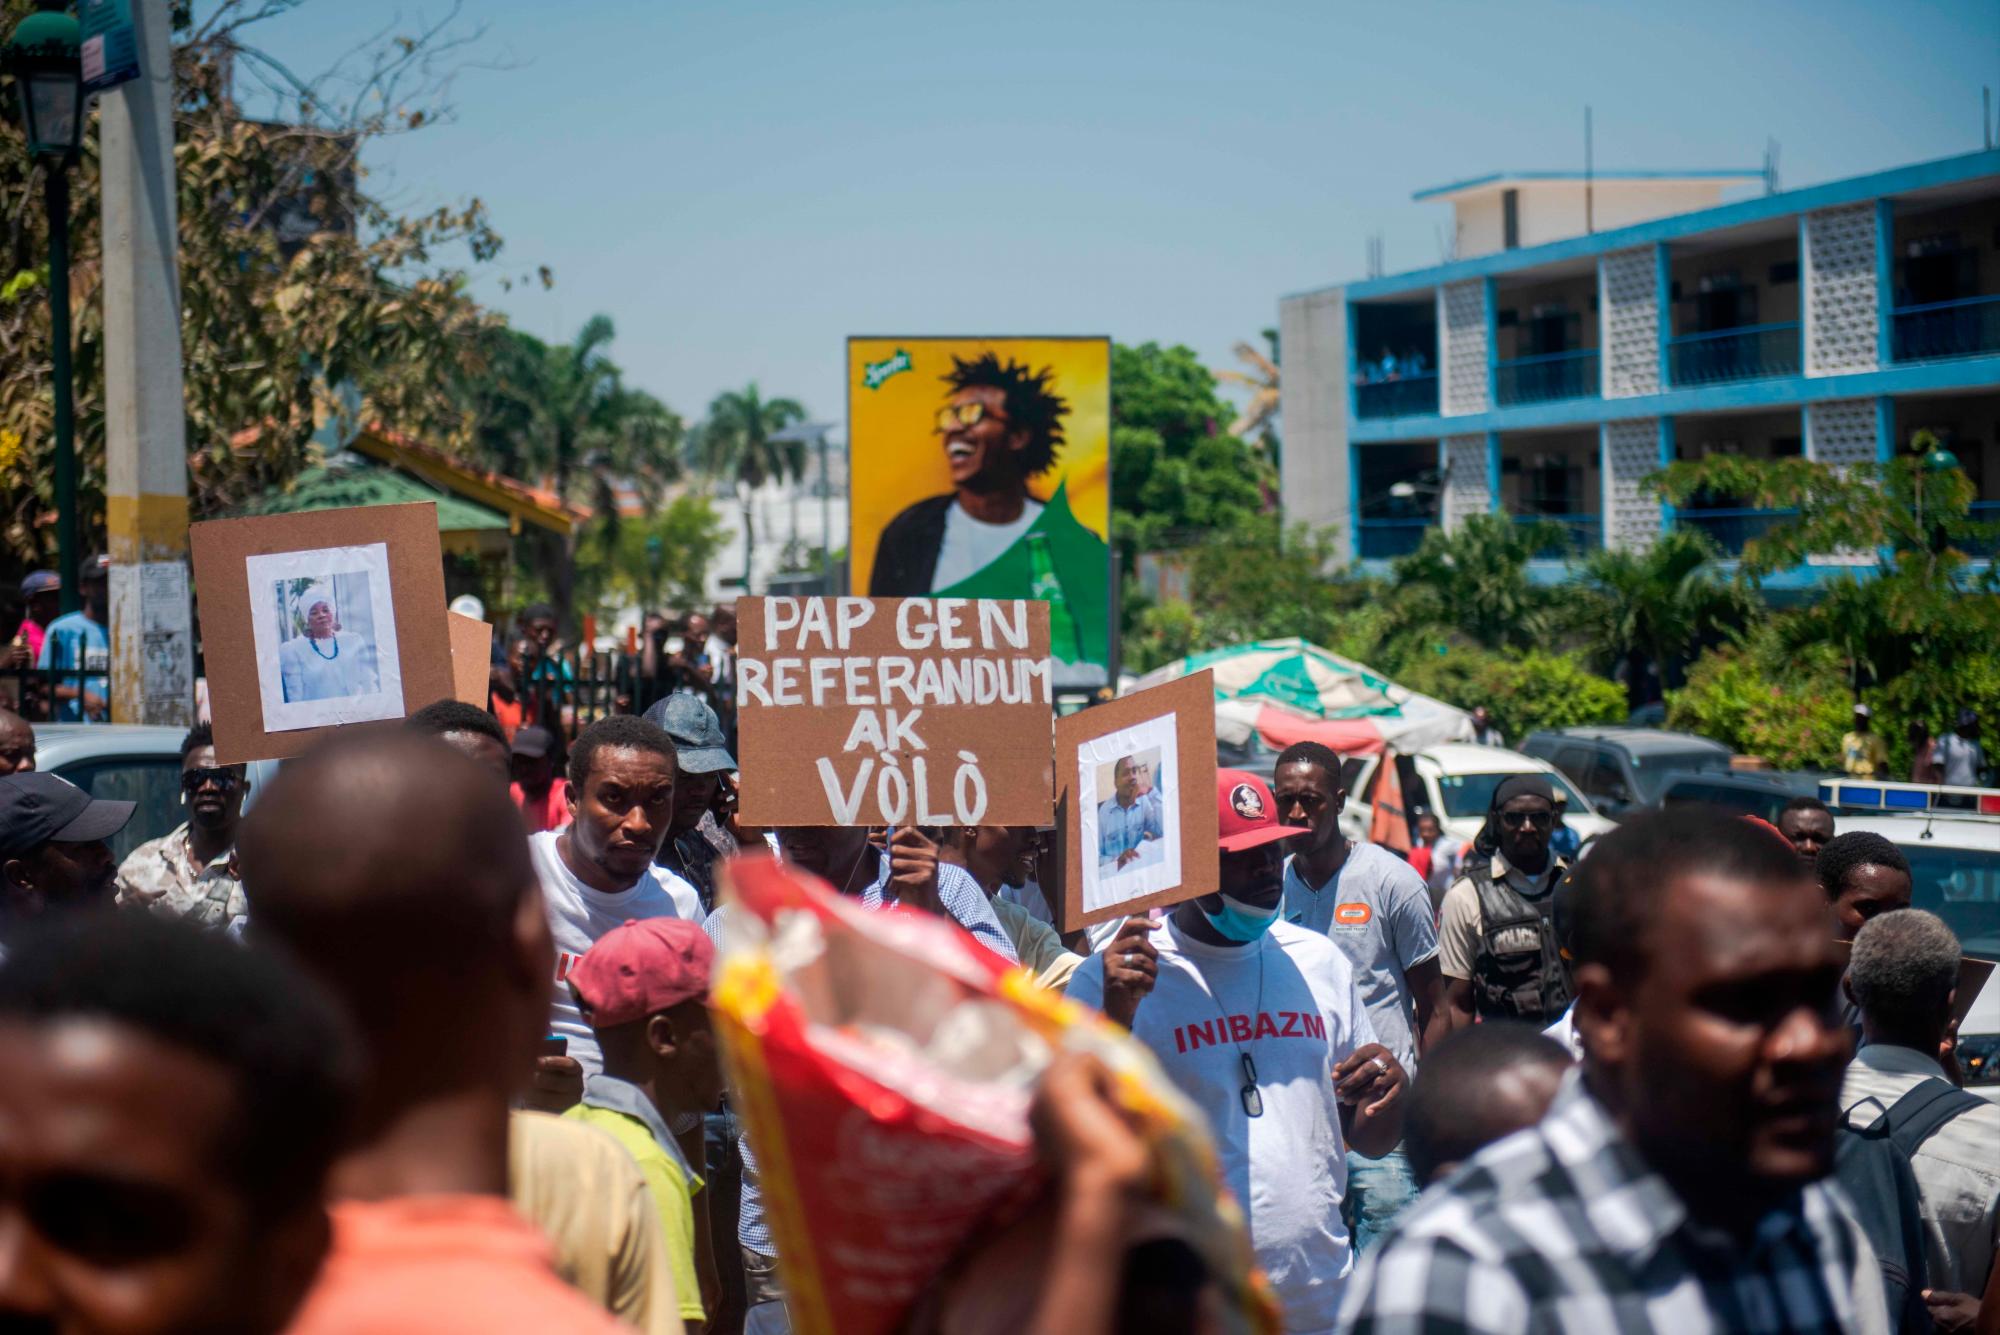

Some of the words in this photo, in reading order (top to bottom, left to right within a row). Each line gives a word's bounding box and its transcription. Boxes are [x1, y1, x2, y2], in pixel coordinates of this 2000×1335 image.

[764, 596, 876, 651] PAP
[896, 597, 1029, 650] GEN
[735, 656, 1051, 706] REFERANDUM
[842, 708, 929, 752] AK
[815, 750, 988, 826] VÒLÒ
